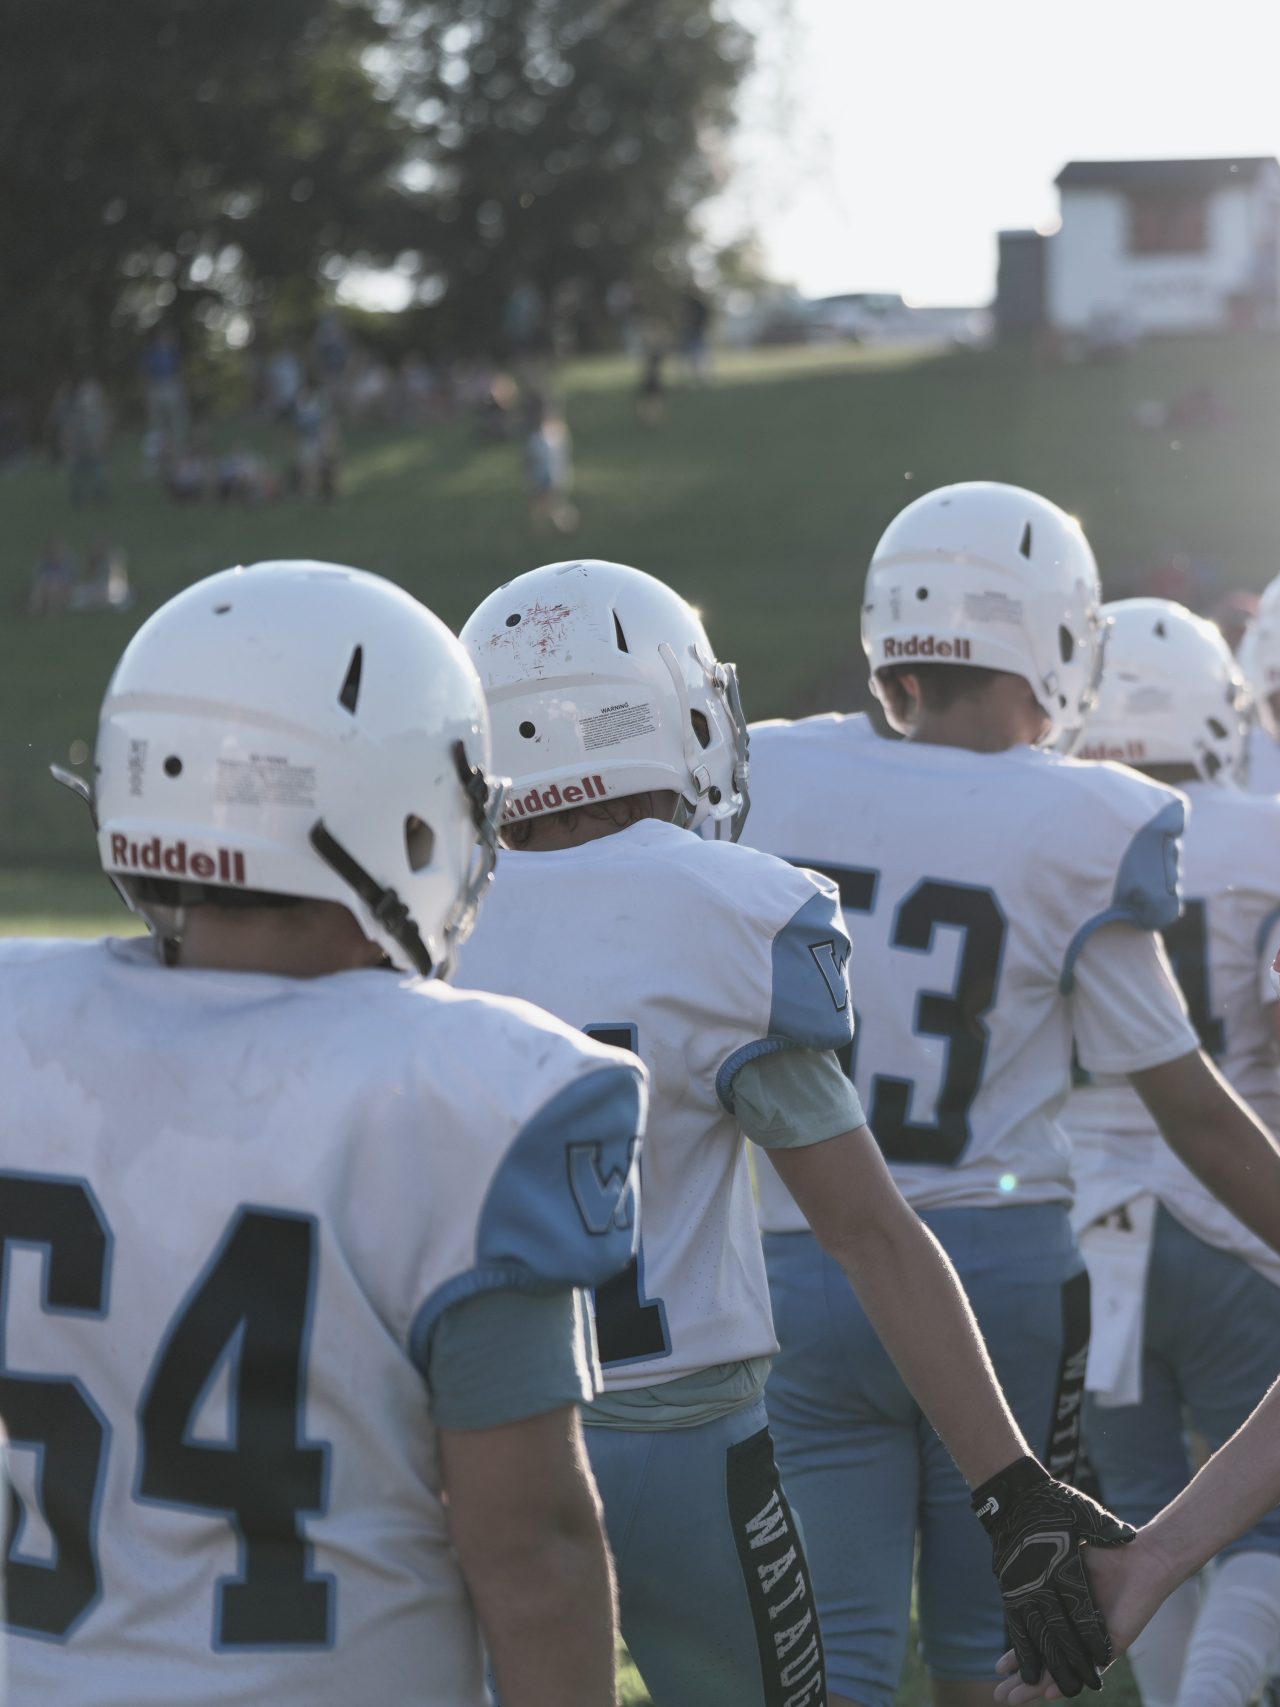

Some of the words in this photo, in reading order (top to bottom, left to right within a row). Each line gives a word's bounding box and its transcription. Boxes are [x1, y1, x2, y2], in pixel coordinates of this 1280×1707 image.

[883, 635, 972, 660] Riddell
[110, 832, 246, 884] Riddell
[745, 1489, 824, 1707] WATAUG
